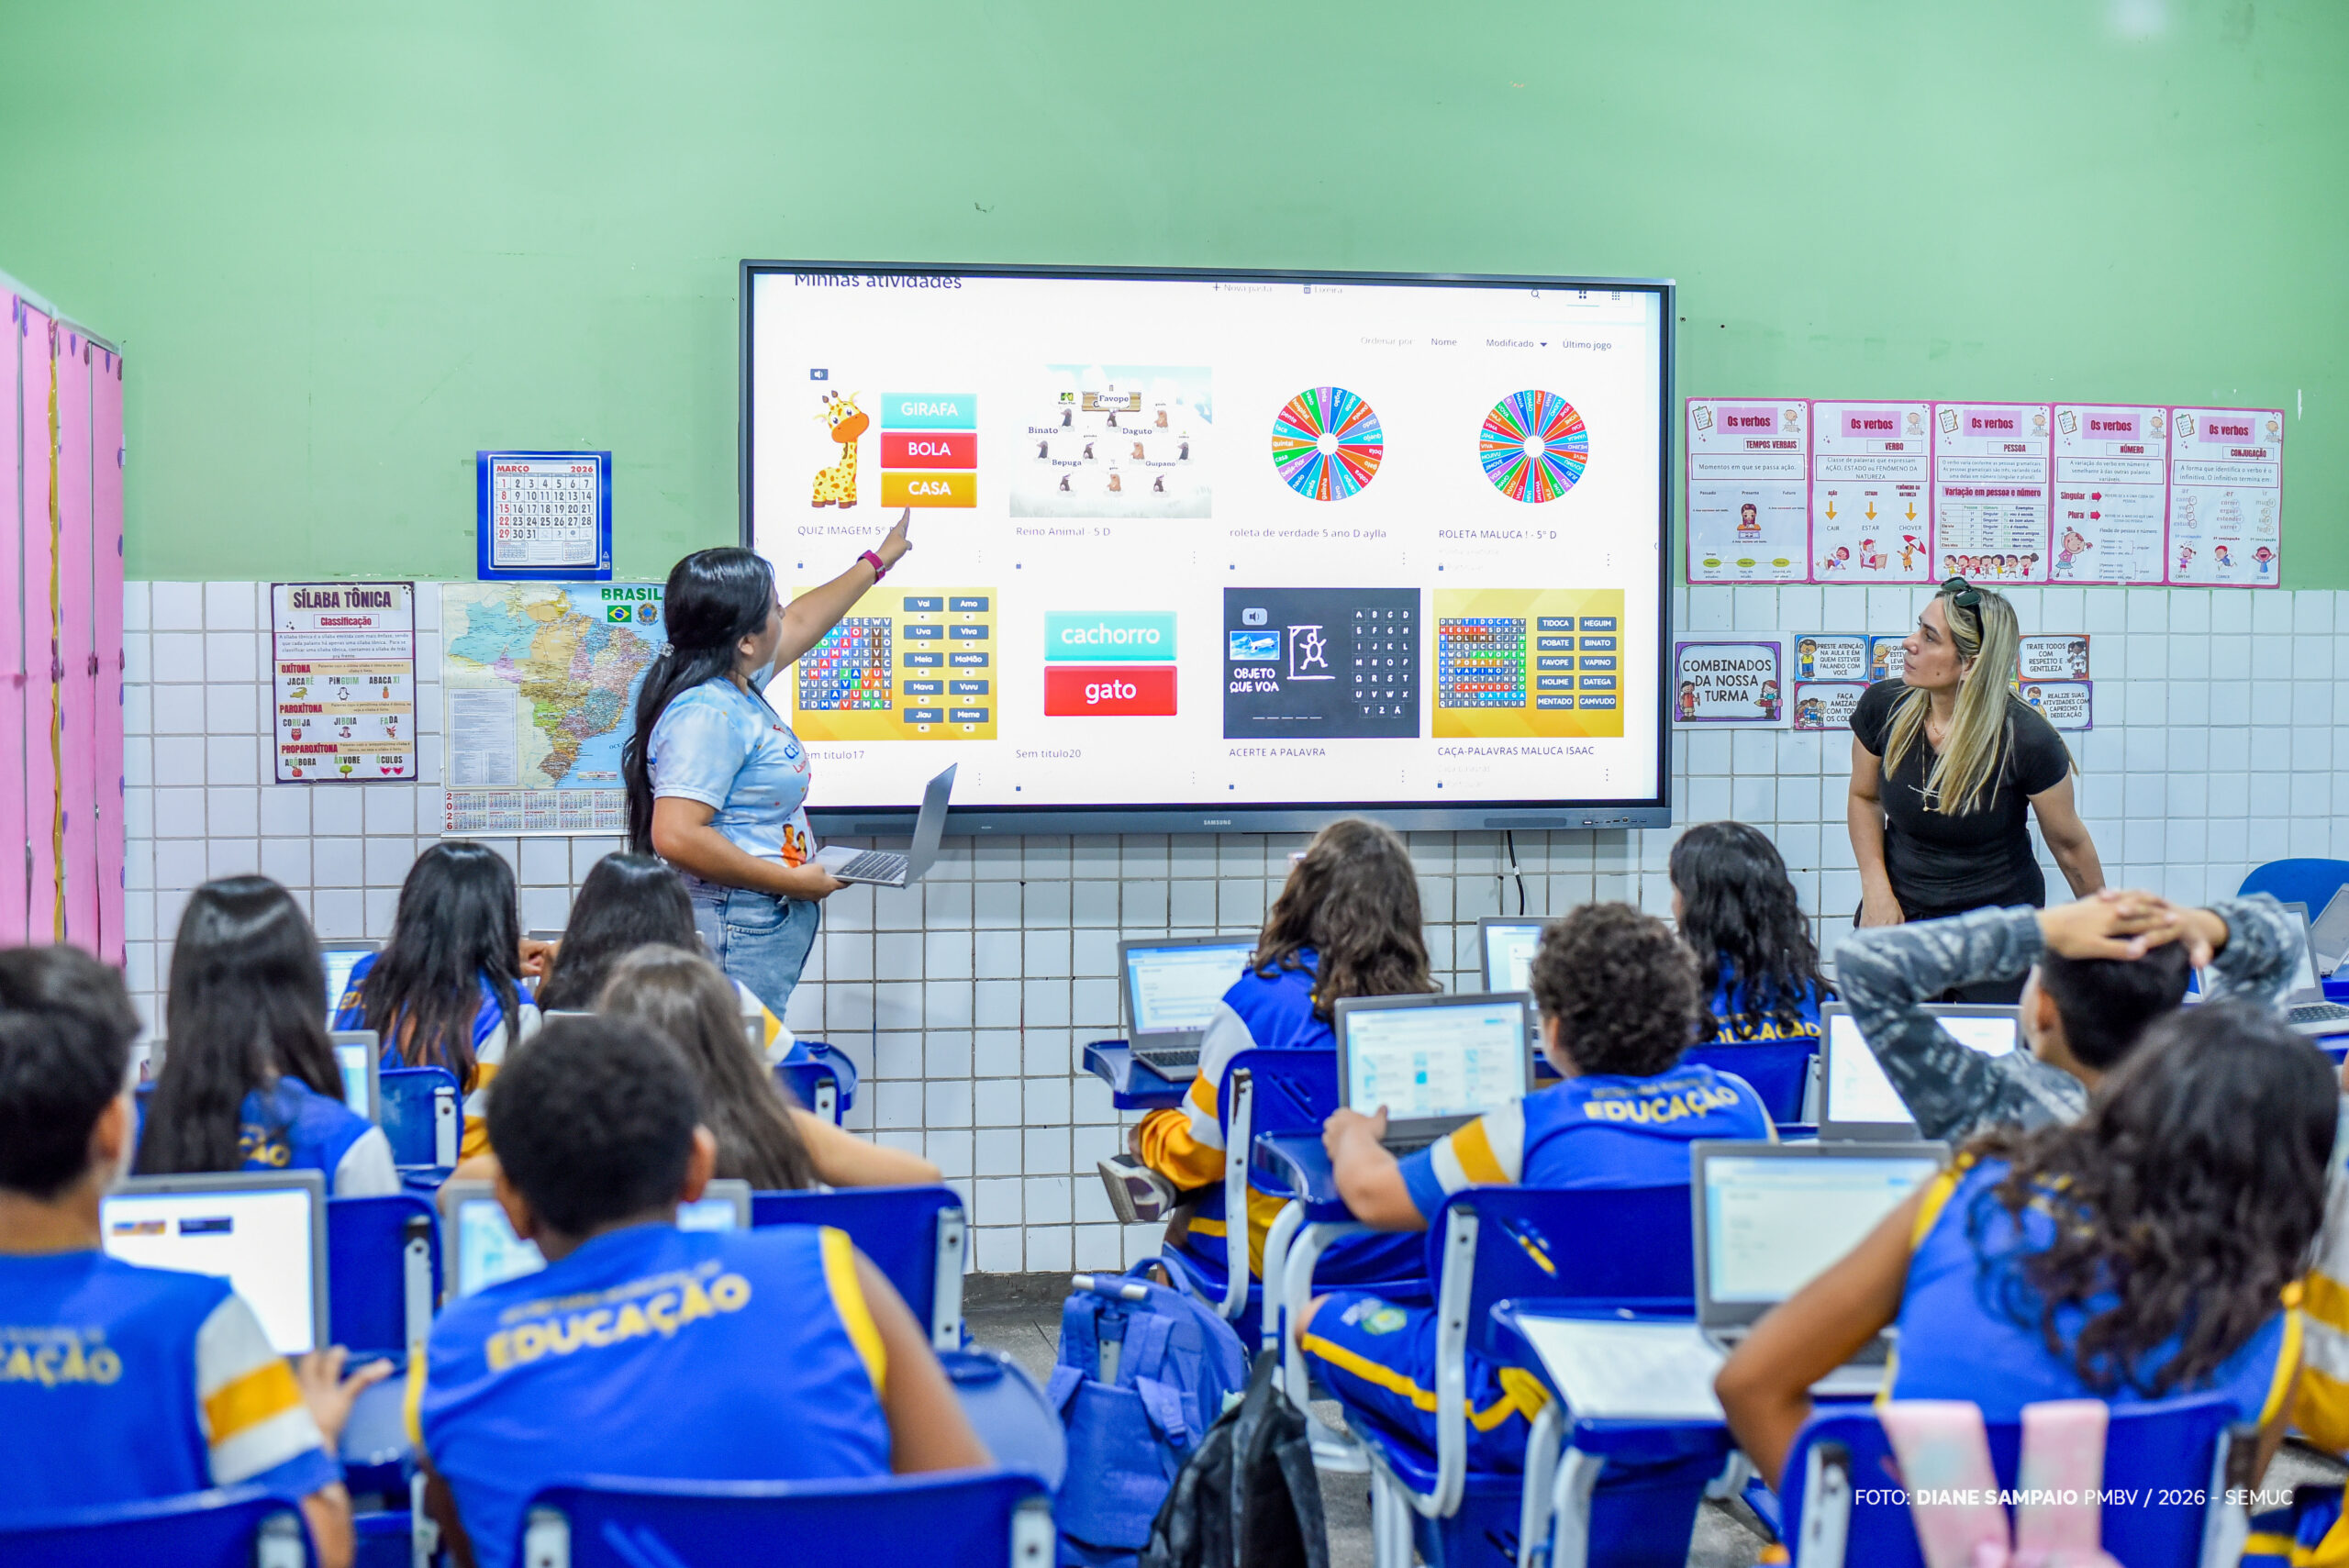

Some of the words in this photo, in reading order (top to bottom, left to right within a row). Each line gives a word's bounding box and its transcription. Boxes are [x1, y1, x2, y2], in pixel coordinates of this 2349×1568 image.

[1486, 339, 1534, 347] Modificado
[1563, 340, 1591, 349] Último
[901, 402, 958, 416] GIRAFA
[1728, 416, 1738, 427] Os
[1741, 417, 1770, 427] verbos
[1851, 418, 1861, 429] Os
[1864, 419, 1893, 429] verbos
[1972, 417, 1982, 428] Os
[1985, 418, 2013, 428] verbos
[2091, 420, 2100, 430] Os
[2103, 421, 2132, 431] verbos
[1123, 428, 1152, 436] Daguto
[2210, 425, 2219, 435] Os
[2221, 426, 2248, 436] verbos
[908, 442, 952, 456] BOLA
[1746, 440, 1770, 449] TEMPOS
[1773, 440, 1797, 449] VERBAIS
[1886, 441, 1903, 450] VERBO
[2004, 443, 2026, 452] PESSOA
[2121, 443, 2143, 453] NÚMERO
[2231, 448, 2266, 460] CONJUGAÇÃO
[503, 479, 506, 488] 1
[516, 479, 520, 488] 2
[529, 479, 534, 488] 3
[543, 479, 548, 488] 4
[557, 479, 562, 488] 5
[571, 479, 575, 488] 6
[584, 479, 589, 488] 7
[908, 481, 952, 495] CASA
[502, 491, 507, 500] 8
[516, 491, 519, 500] 9
[527, 491, 537, 500] 10
[541, 491, 550, 500] 11
[554, 491, 563, 500] 12
[569, 491, 577, 500] 13
[582, 491, 591, 500] 14
[1945, 487, 1973, 498] Variação
[1987, 489, 2009, 497] pessoa
[2017, 488, 2041, 496] número
[2061, 492, 2085, 500] Singular
[798, 526, 823, 536] QUIZ
[828, 526, 871, 535] IMAGEM
[1017, 528, 1045, 536] Reino
[1049, 528, 1084, 536] Animal
[1095, 528, 1099, 536] 5
[1230, 528, 1260, 537] roleta
[1264, 528, 1275, 537] de
[1353, 529, 1360, 538] D
[1364, 529, 1386, 540] aylla
[1439, 530, 1476, 539] ROLETA
[1481, 530, 1522, 539] MALUCA
[294, 588, 340, 608] SÍLABA
[344, 587, 392, 607] TÔNICA
[601, 588, 662, 601] BRASIL
[321, 617, 372, 628] Classificação
[1062, 623, 1160, 644] cachorro
[282, 663, 311, 673] OXÍTONA
[1683, 660, 1771, 672] COMBINADOS
[1234, 668, 1275, 679] OBJETO
[287, 677, 314, 685] JACARÉ
[1696, 675, 1711, 686] DA
[1716, 675, 1758, 686] NOSSA
[1085, 680, 1137, 704] gato
[1230, 682, 1252, 693] QUE
[1255, 682, 1279, 692] VOA
[1705, 690, 1749, 702] TURMA
[280, 703, 322, 713] PAROXÍTONA
[381, 716, 397, 724] FADA
[282, 742, 338, 753] PROPAROXÍTONA
[1280, 748, 1325, 756] PALAVRA
[1438, 747, 1518, 758] CAÇA-PALAVRAS
[1521, 747, 1563, 755] MALUCA
[1566, 747, 1594, 755] ISAAC
[376, 754, 403, 764] ÓCULOS
[1016, 750, 1038, 758] Sem
[285, 758, 316, 766] ABÓBORA
[1584, 1085, 1739, 1123] EDUCAÇÃO
[486, 1273, 751, 1372] EDUCAÇÃO
